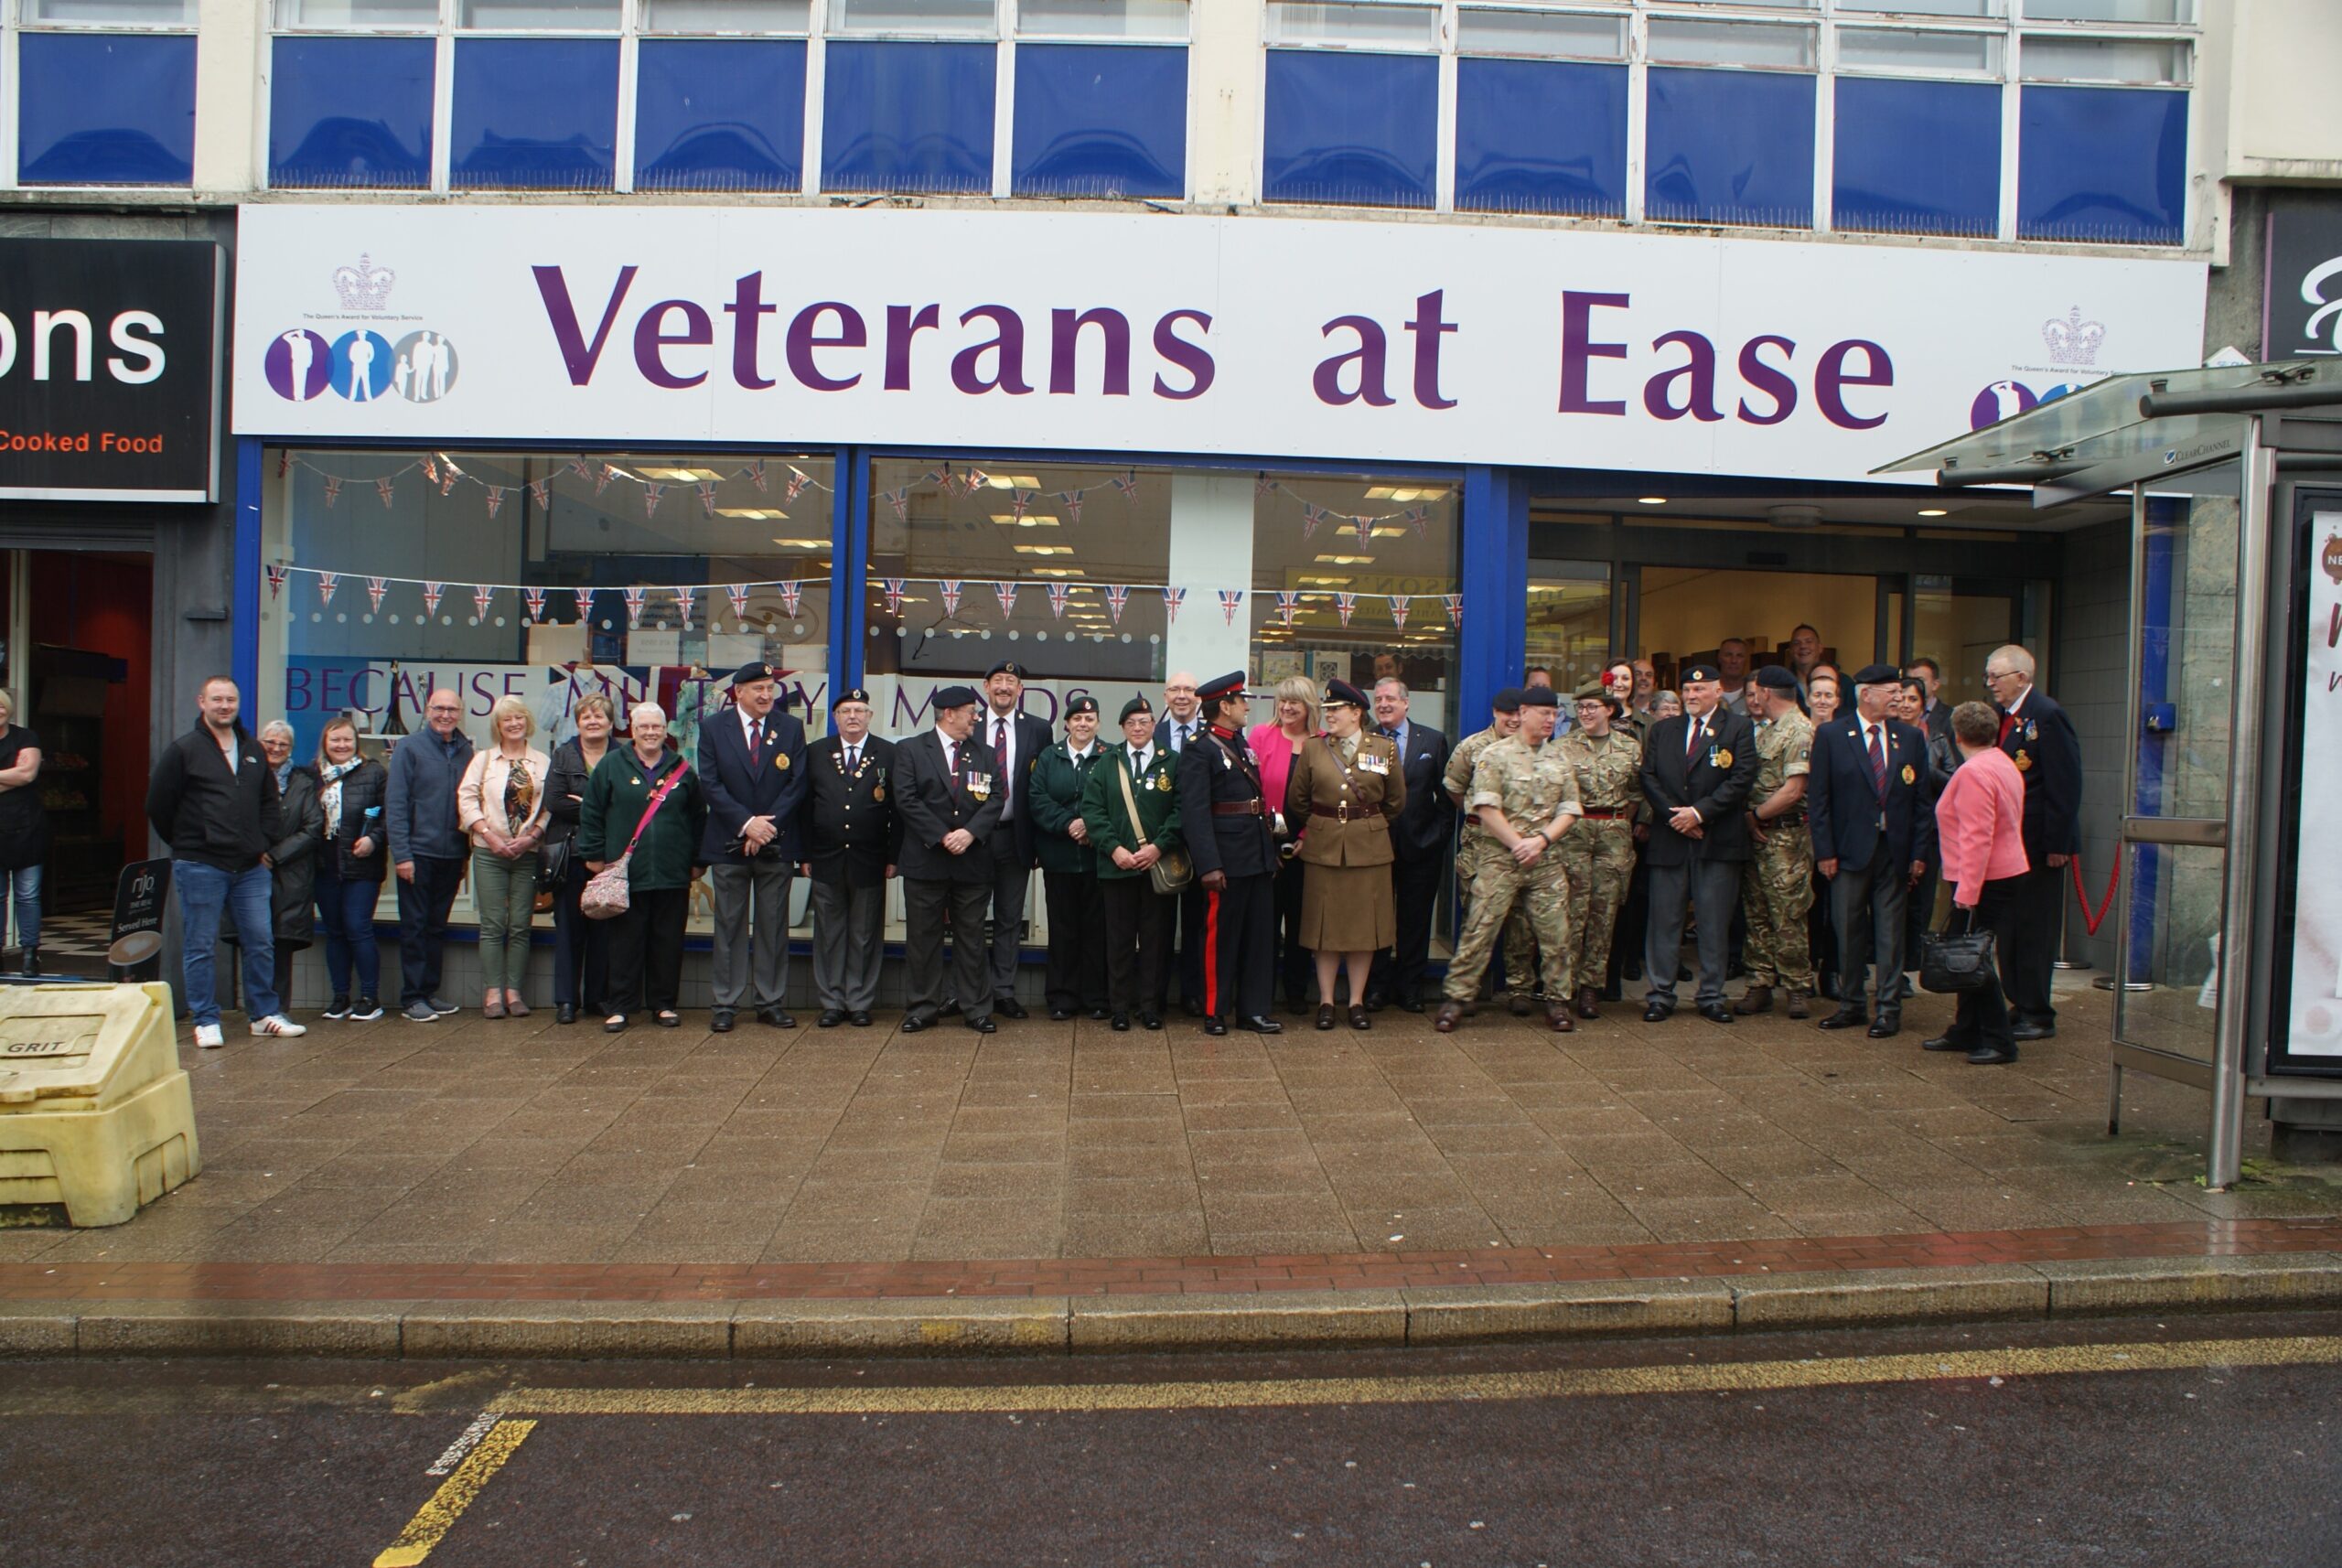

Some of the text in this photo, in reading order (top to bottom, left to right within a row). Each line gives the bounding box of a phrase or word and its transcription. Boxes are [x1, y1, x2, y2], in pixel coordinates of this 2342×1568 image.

[0, 308, 167, 384] ns
[531, 264, 1895, 431] Veterans at Ease
[2080, 368, 2109, 377] Voluntary
[0, 430, 164, 454] Cooked Food
[116, 917, 158, 933] Served Here
[7, 1041, 67, 1053] GRIT
